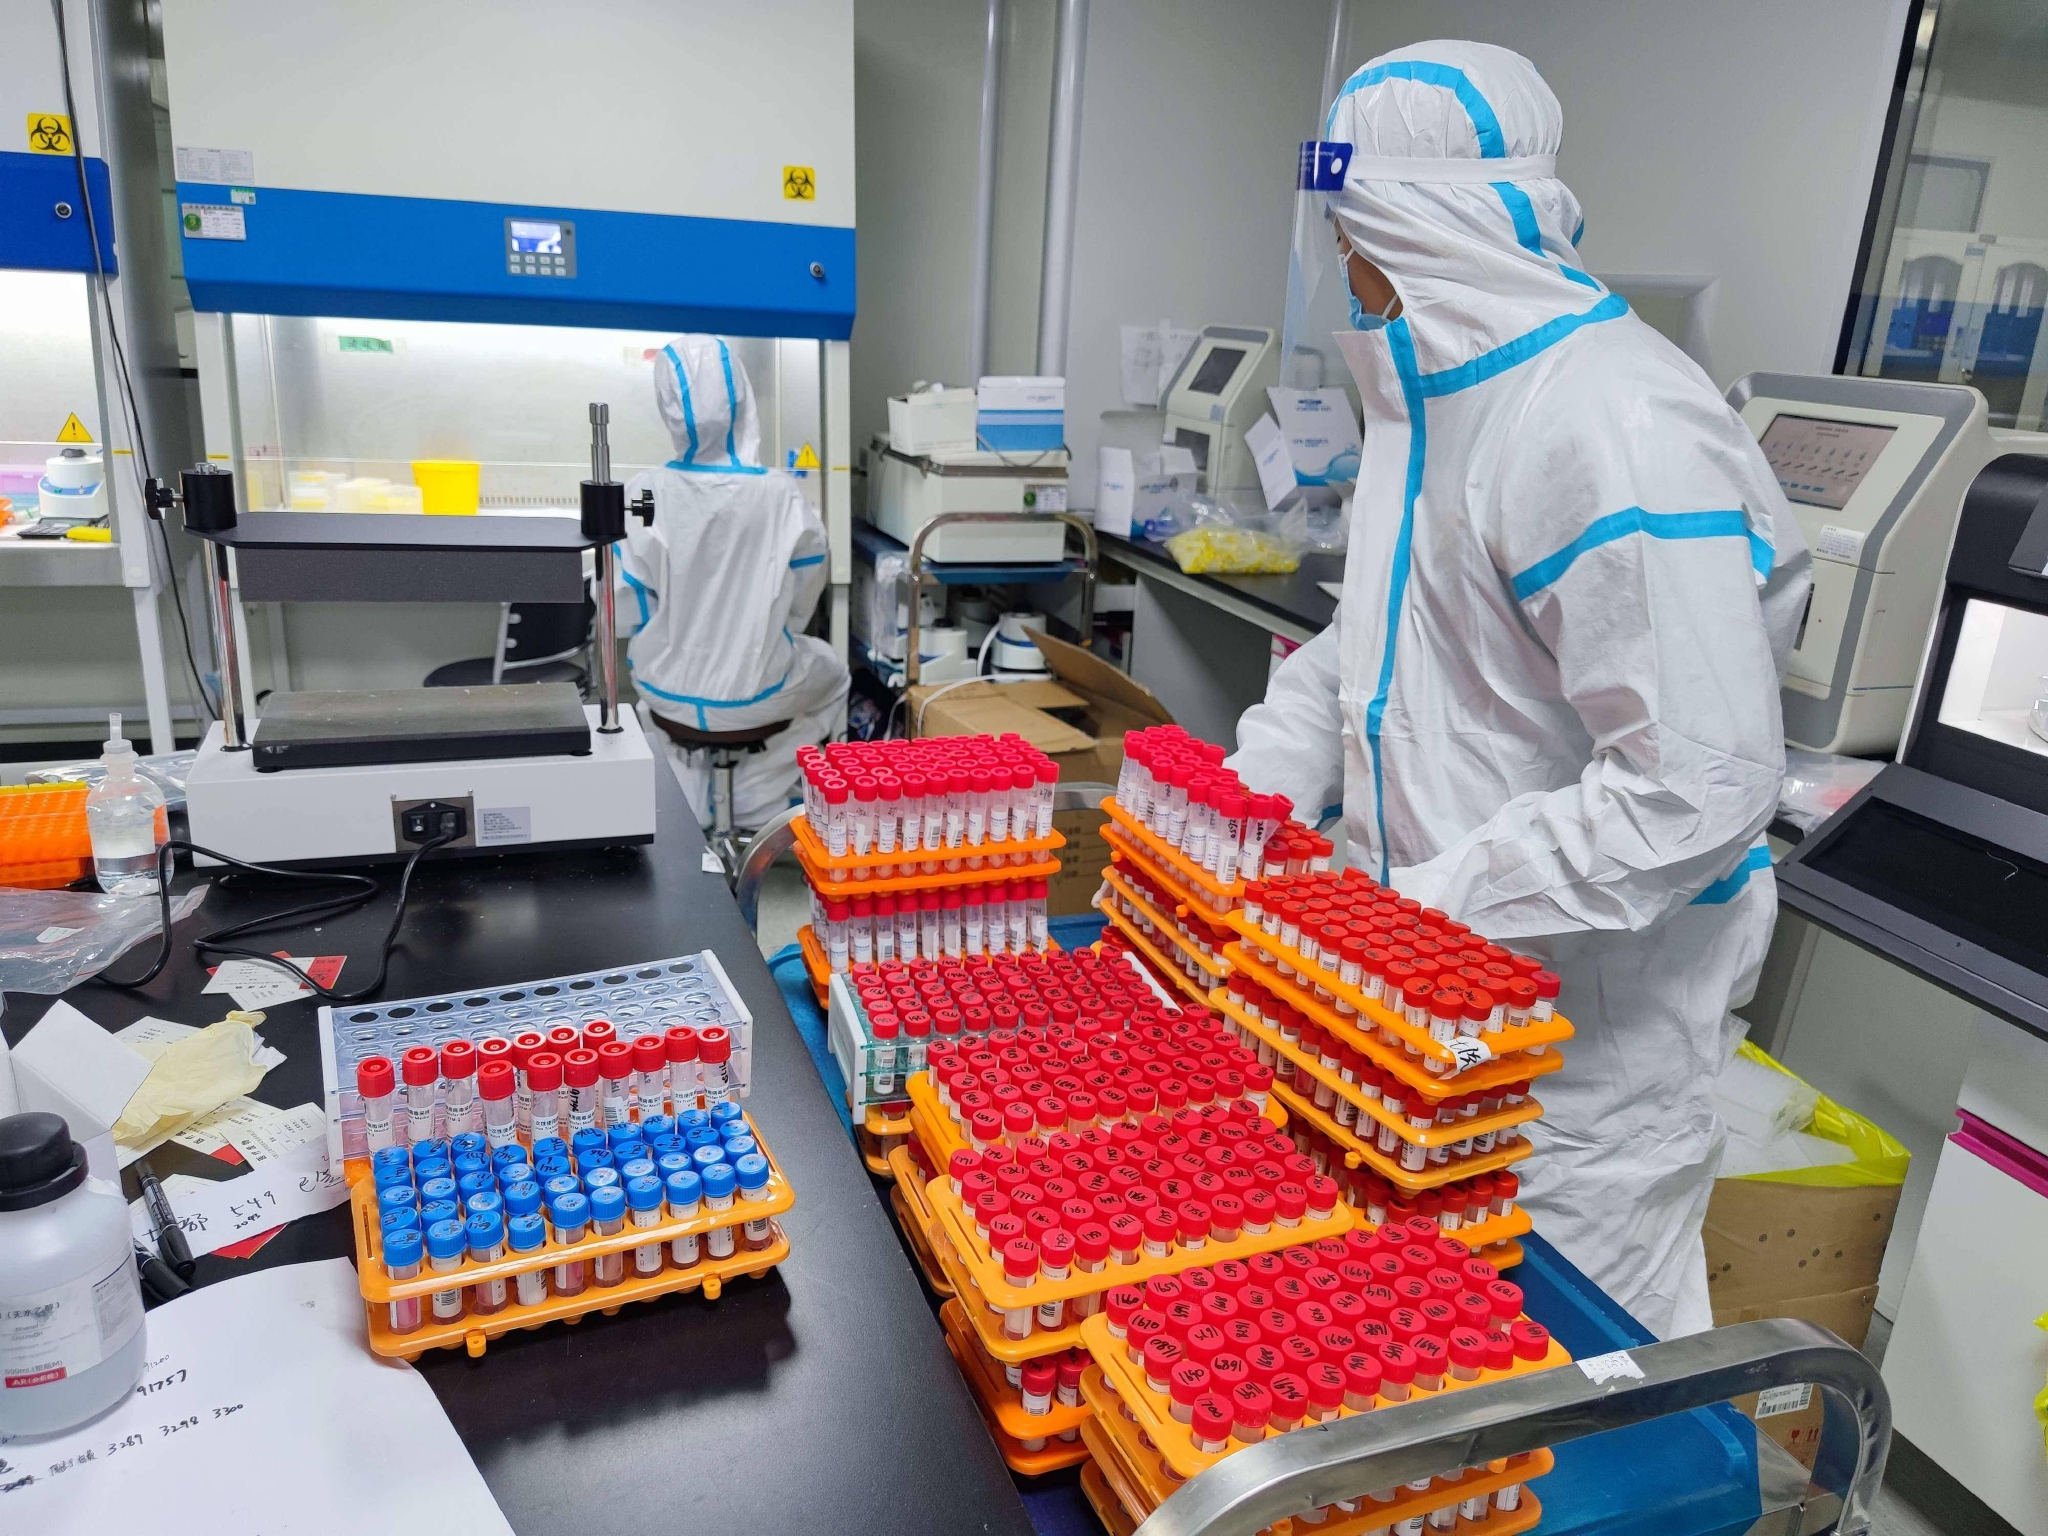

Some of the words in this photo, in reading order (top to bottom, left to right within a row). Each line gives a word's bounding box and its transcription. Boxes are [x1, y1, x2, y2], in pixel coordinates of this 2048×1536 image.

[1255, 1165, 1280, 1178] 1769
[1199, 1173, 1214, 1186] 1767
[1047, 1182, 1062, 1192] 1773
[1280, 1186, 1304, 1194] 1759
[1013, 1190, 1036, 1200] 1772
[1098, 1196, 1122, 1204] 1764
[1252, 1190, 1271, 1203] 1758
[1184, 1204, 1205, 1217] 1756
[1217, 1200, 1238, 1208] 1757
[994, 1221, 1014, 1230] 1761
[1113, 1216, 1135, 1228] 1754
[1015, 1243, 1034, 1251] 1751
[1286, 1250, 1311, 1265] 1655
[1408, 1248, 1428, 1261] 1662
[1345, 1266, 1371, 1280] 1664
[1435, 1276, 1457, 1284] 1672
[1154, 1281, 1180, 1294] 1659
[1210, 1296, 1227, 1312] 1668
[1250, 1291, 1264, 1305] 1667
[1132, 1315, 1160, 1329] 1670
[1236, 1322, 1250, 1338] 1678
[1150, 1339, 1180, 1358] 1680
[1215, 1358, 1241, 1372] 1689
[137, 1369, 187, 1396] 91757
[1178, 1369, 1204, 1384] 1690
[1197, 1398, 1223, 1417] 1700
[107, 1433, 144, 1456] 3289
[159, 1416, 199, 1437] 3298
[212, 1404, 244, 1420] 3300
